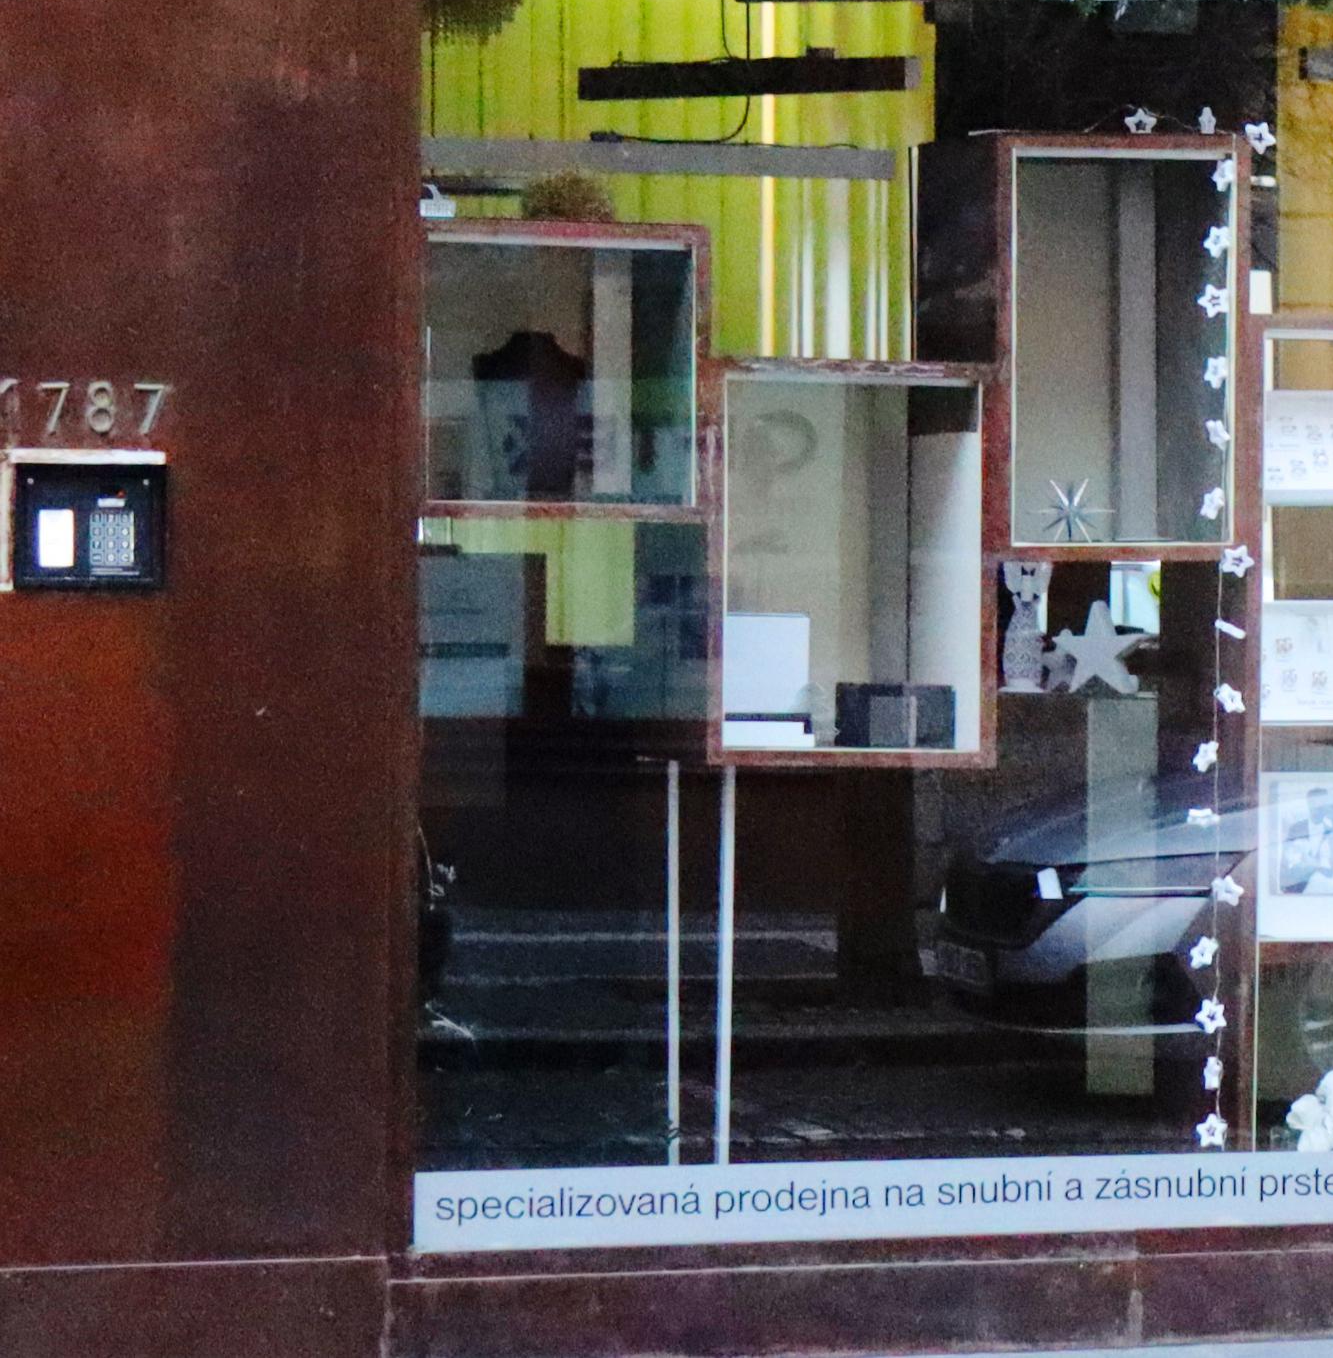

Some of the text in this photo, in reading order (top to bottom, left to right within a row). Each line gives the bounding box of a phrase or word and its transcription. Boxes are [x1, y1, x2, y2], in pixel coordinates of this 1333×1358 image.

[434, 1183, 701, 1226] specializovaná
[714, 1180, 871, 1218] prodejna
[884, 1184, 926, 1210] na
[937, 1171, 1053, 1206] snubní
[1064, 1179, 1084, 1203] a
[1095, 1166, 1247, 1202] zásnubní
